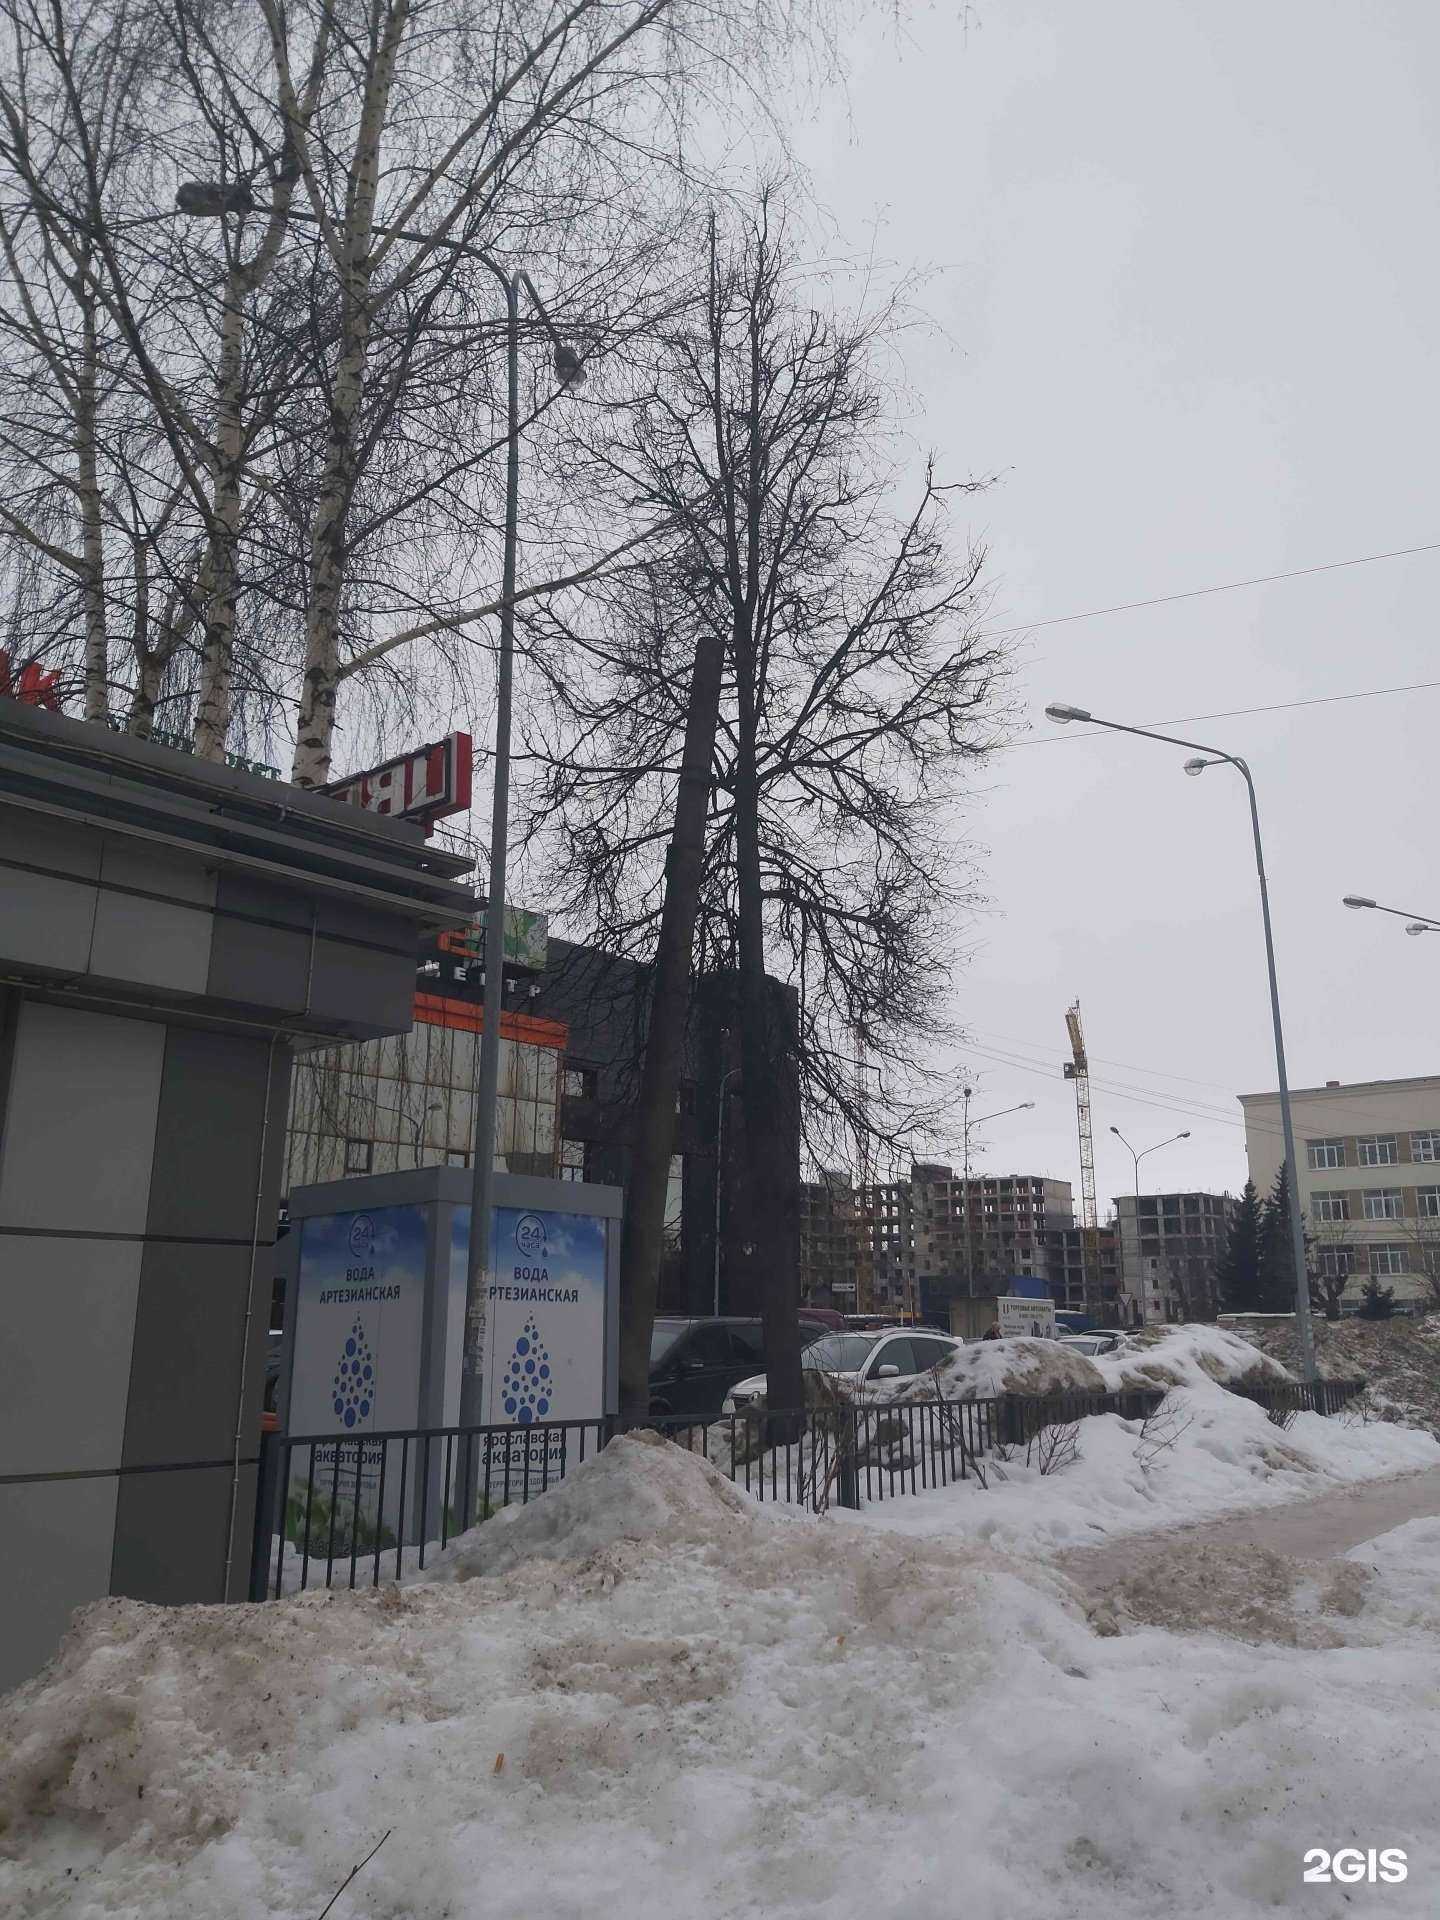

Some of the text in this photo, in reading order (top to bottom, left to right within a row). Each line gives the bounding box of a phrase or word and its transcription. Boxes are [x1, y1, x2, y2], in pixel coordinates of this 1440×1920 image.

[353, 1227, 369, 1241] 24
[521, 1226, 541, 1240] 24
[345, 1267, 375, 1282] ВОДА
[514, 1267, 549, 1283] ВОДА
[320, 1285, 400, 1304] АРТЕЗИАНСКАЯ
[489, 1286, 579, 1303] РТЕЗИАНСКАЯ
